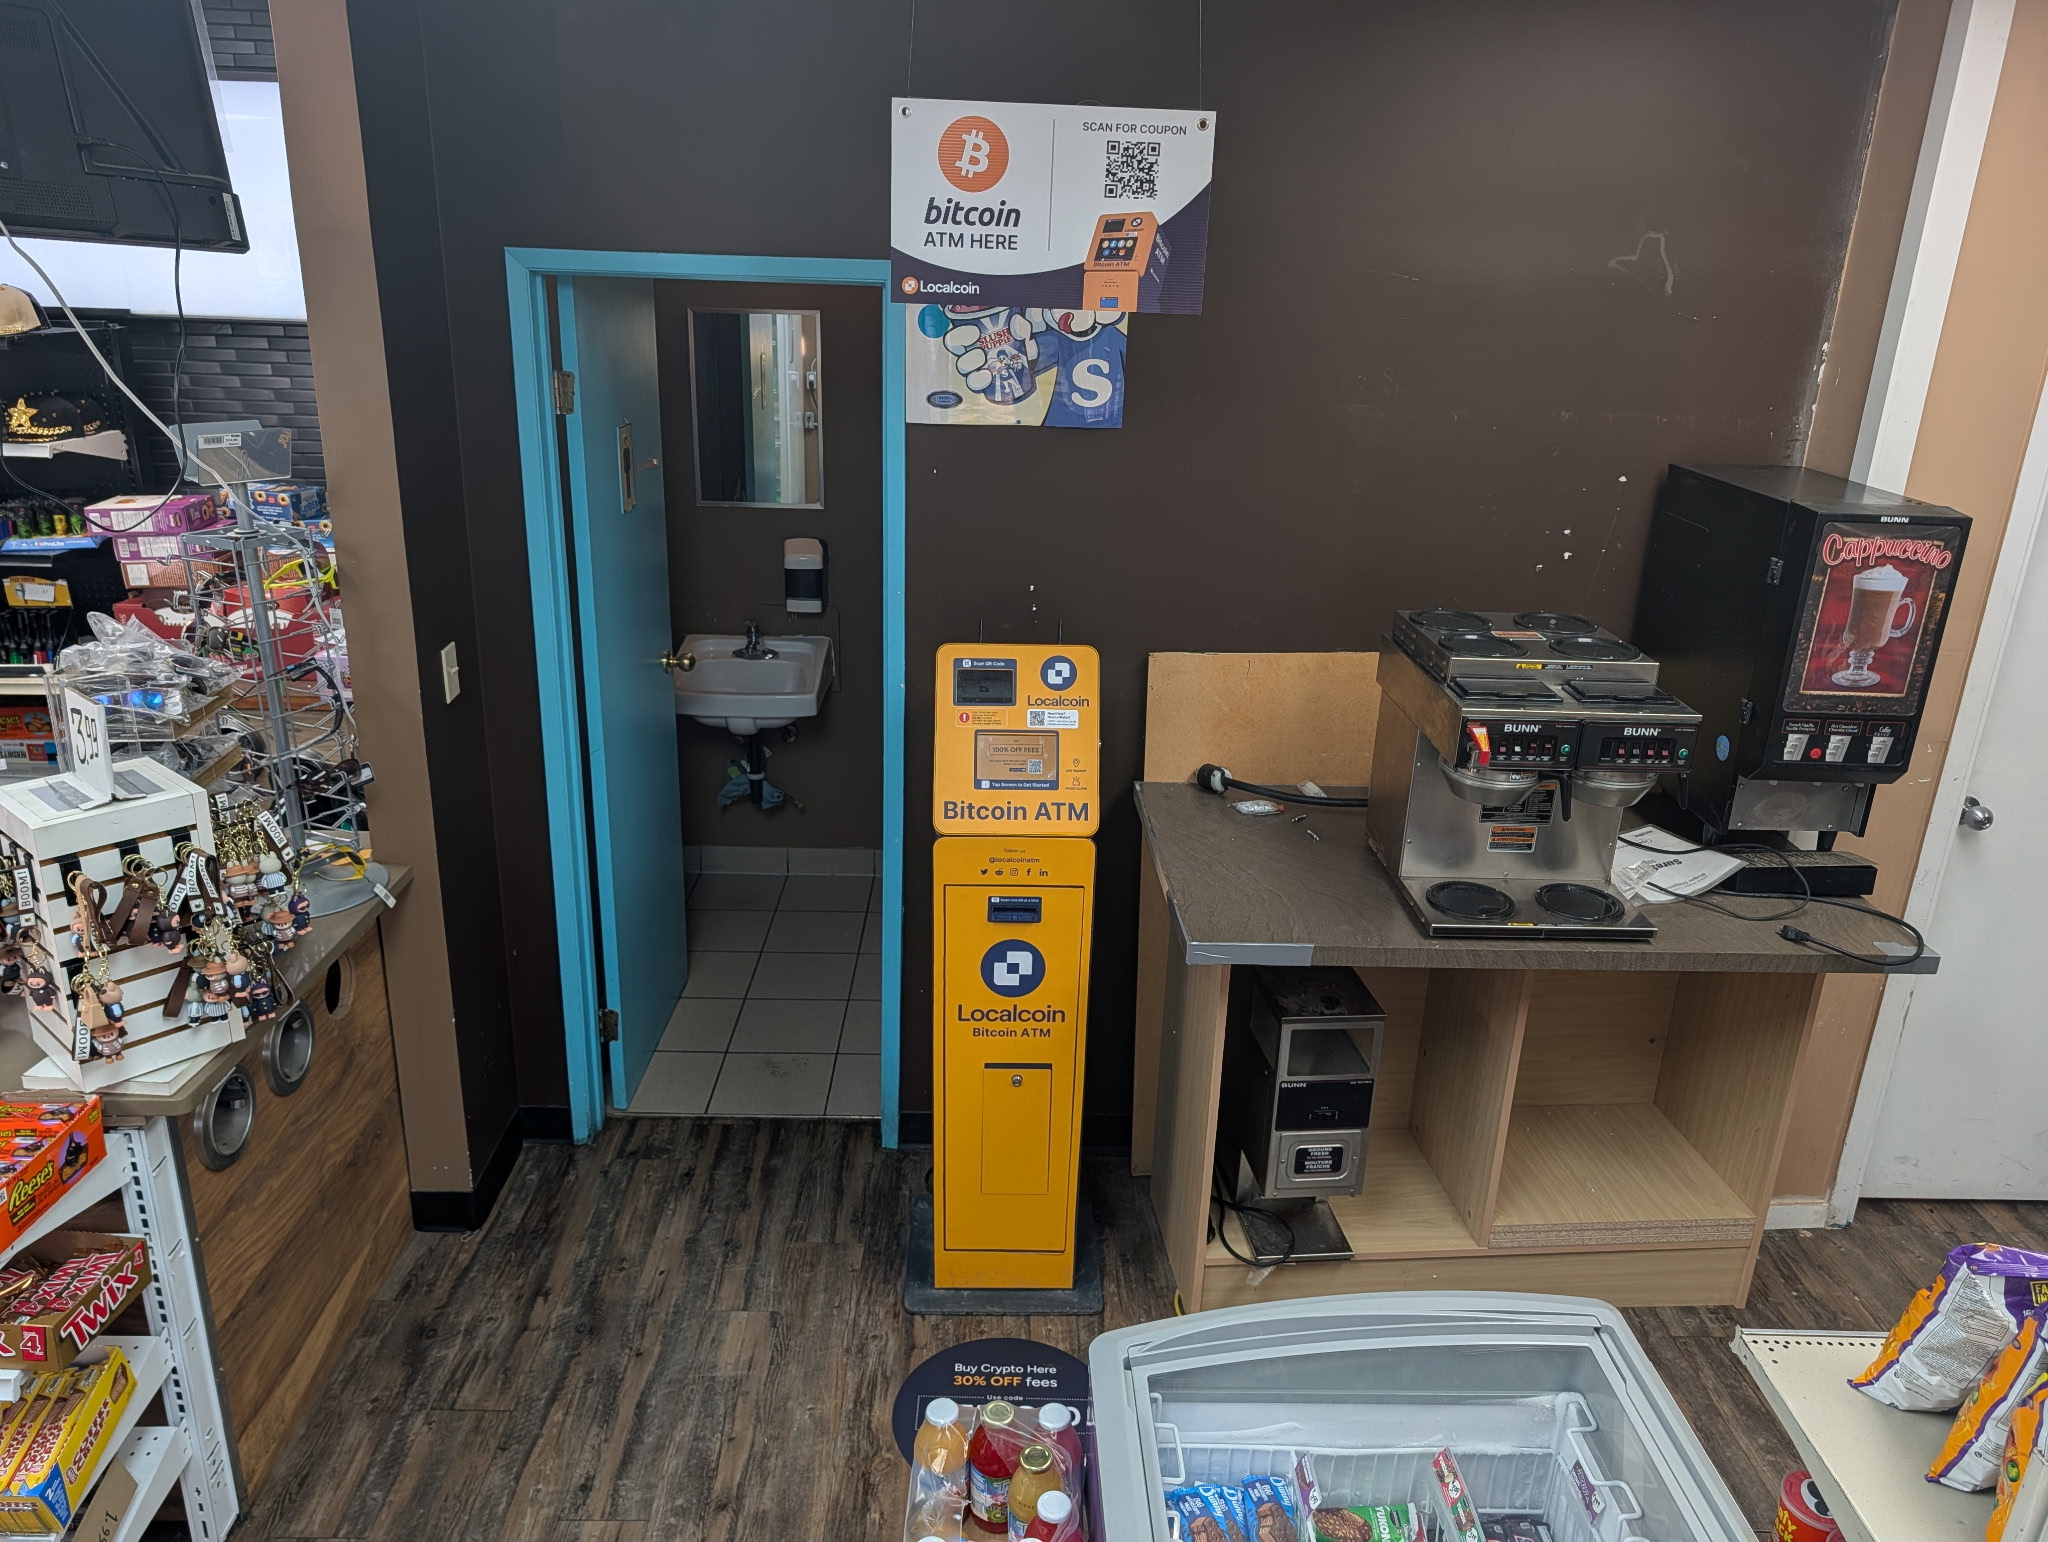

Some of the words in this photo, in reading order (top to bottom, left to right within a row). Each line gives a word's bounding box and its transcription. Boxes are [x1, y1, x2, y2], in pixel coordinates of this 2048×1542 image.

[1082, 121, 1113, 133] SCAN
[1115, 123, 1137, 134] FOR
[1140, 124, 1187, 136] COUPON
[923, 197, 1021, 228] bitcoin
[923, 231, 965, 249] ATM
[970, 234, 1019, 251] HERE
[919, 280, 980, 295] Localcoin
[978, 327, 1010, 346] SLUSH
[1880, 516, 1910, 524] BUNN
[1822, 533, 1952, 570] Cappuccino
[1027, 694, 1090, 707] Localcoin
[70, 707, 99, 766] 3.99
[1503, 723, 1539, 733] BUNN
[1623, 727, 1659, 736] BUNN
[943, 800, 1027, 820] Bitcoin
[1034, 802, 1089, 821] ATM
[259, 812, 285, 846] BOOM!
[988, 856, 1040, 864] @localcoinatm
[189, 854, 198, 894] BOOM!
[19, 870, 31, 908] BOOM!
[957, 1003, 1066, 1023] Localcoin
[972, 1027, 1017, 1037] Bitcoin
[1020, 1027, 1051, 1038] ATM
[7, 1159, 55, 1214] Reese's
[954, 1363, 979, 1375] Buy
[980, 1364, 1024, 1376] Crypto
[1027, 1365, 1057, 1374] Here
[953, 1375, 987, 1386] 30%
[990, 1376, 1023, 1387] OFF
[1025, 1377, 1058, 1388] fees
[1374, 1506, 1391, 1542] YUKON
[1777, 1506, 1798, 1533] RTY
